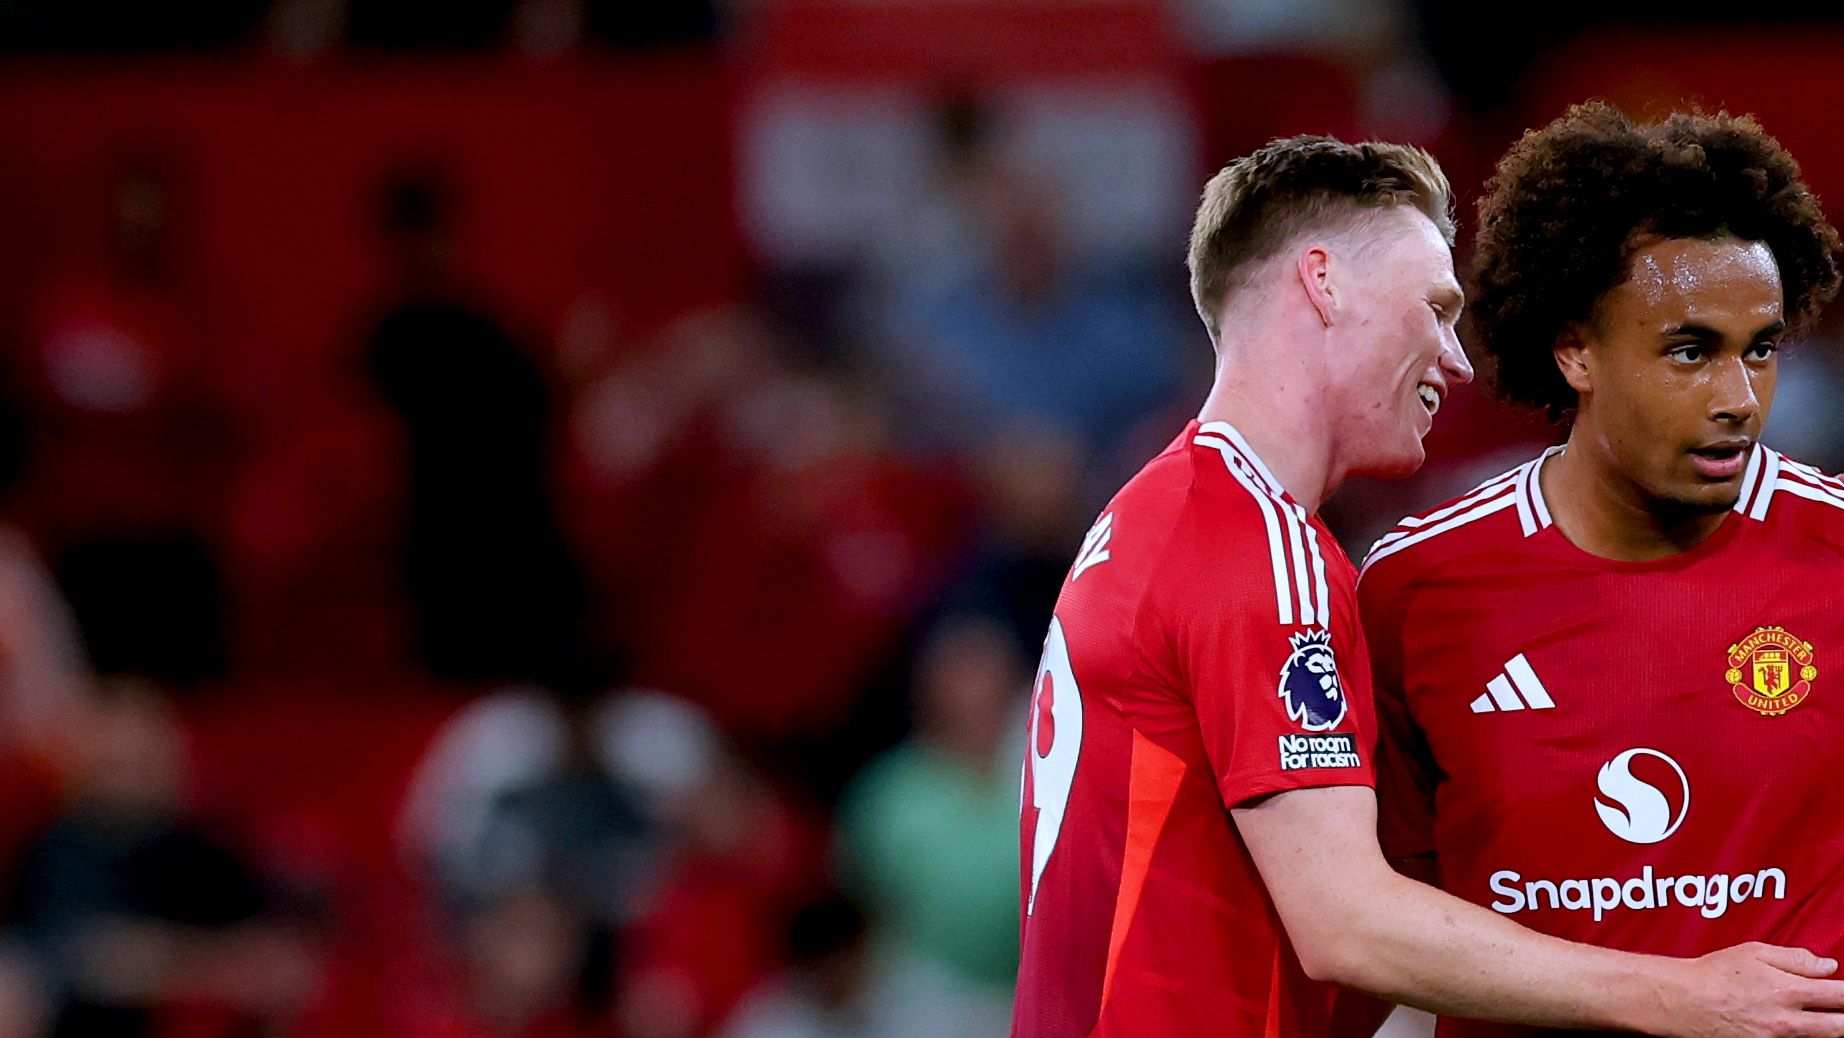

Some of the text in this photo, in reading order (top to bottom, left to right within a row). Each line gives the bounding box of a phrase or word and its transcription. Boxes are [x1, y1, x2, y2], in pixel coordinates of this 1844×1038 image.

[1735, 632, 1807, 661] MANCHESTER
[1748, 693, 1798, 710] UNITED
[1278, 734, 1351, 754] No room
[1019, 613, 1084, 917] 9
[1310, 753, 1361, 768] racism
[1489, 865, 1786, 922] Snapdragon
